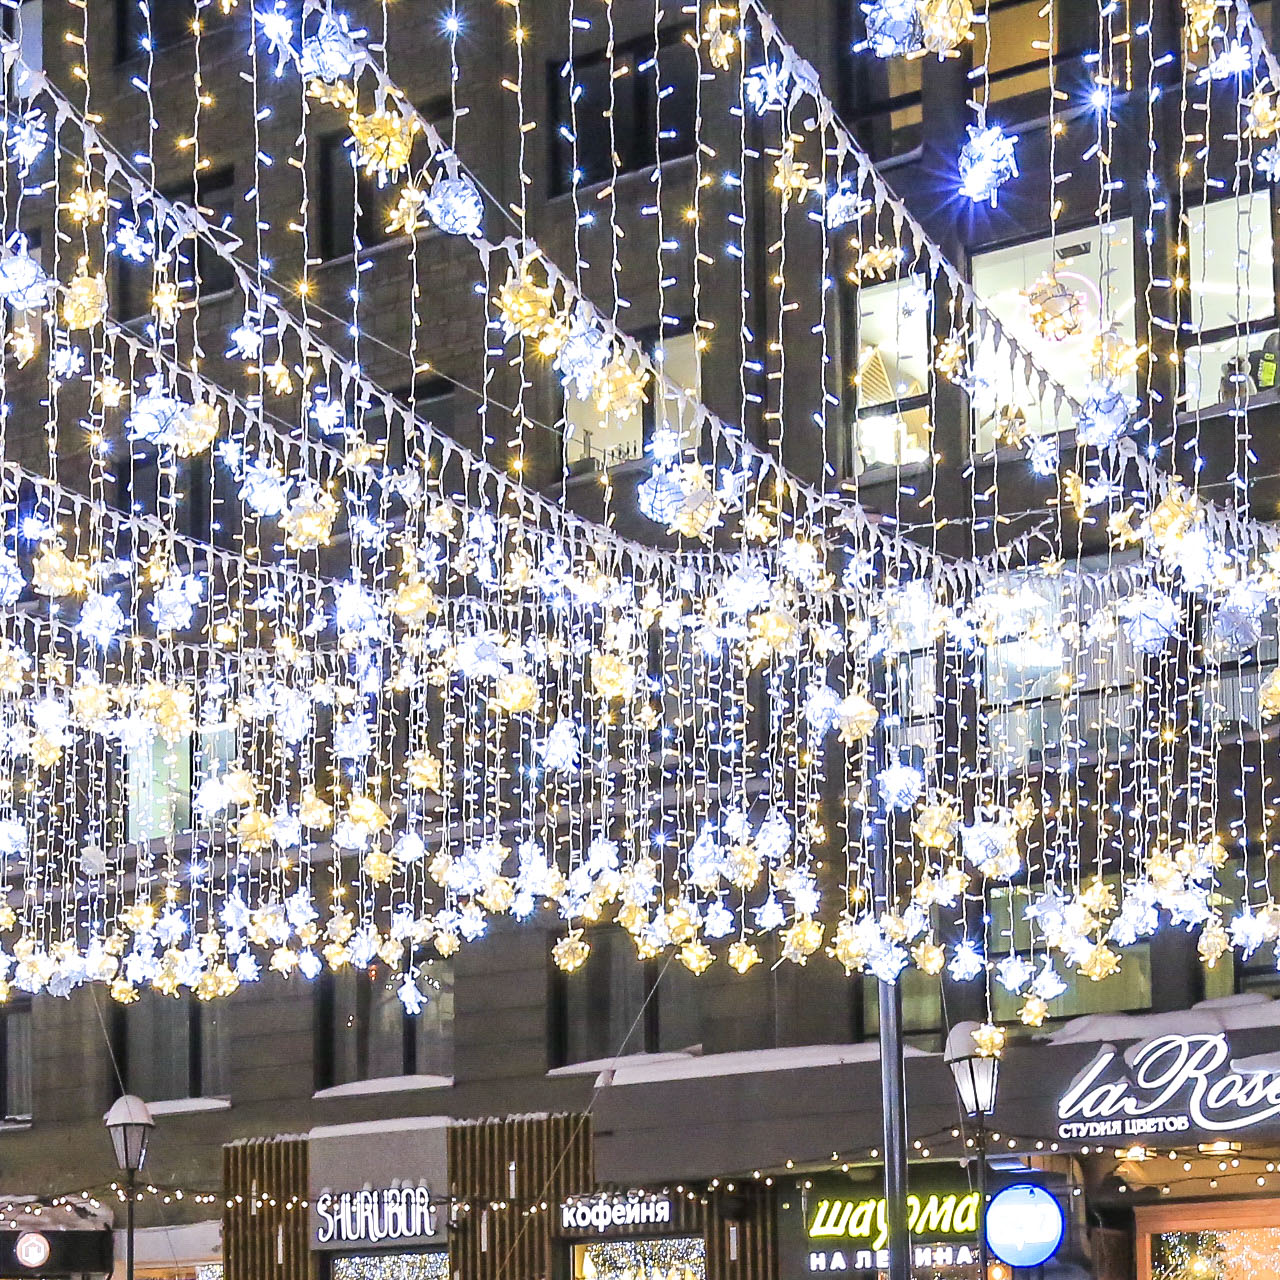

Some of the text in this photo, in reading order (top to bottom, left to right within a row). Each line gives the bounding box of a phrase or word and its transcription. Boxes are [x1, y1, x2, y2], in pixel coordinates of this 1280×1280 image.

[317, 1186, 436, 1243] SHURUBOR
[561, 1197, 670, 1233] кофейня
[808, 1191, 980, 1251] шаума
[809, 1246, 973, 1271] НА ЛЕИНА
